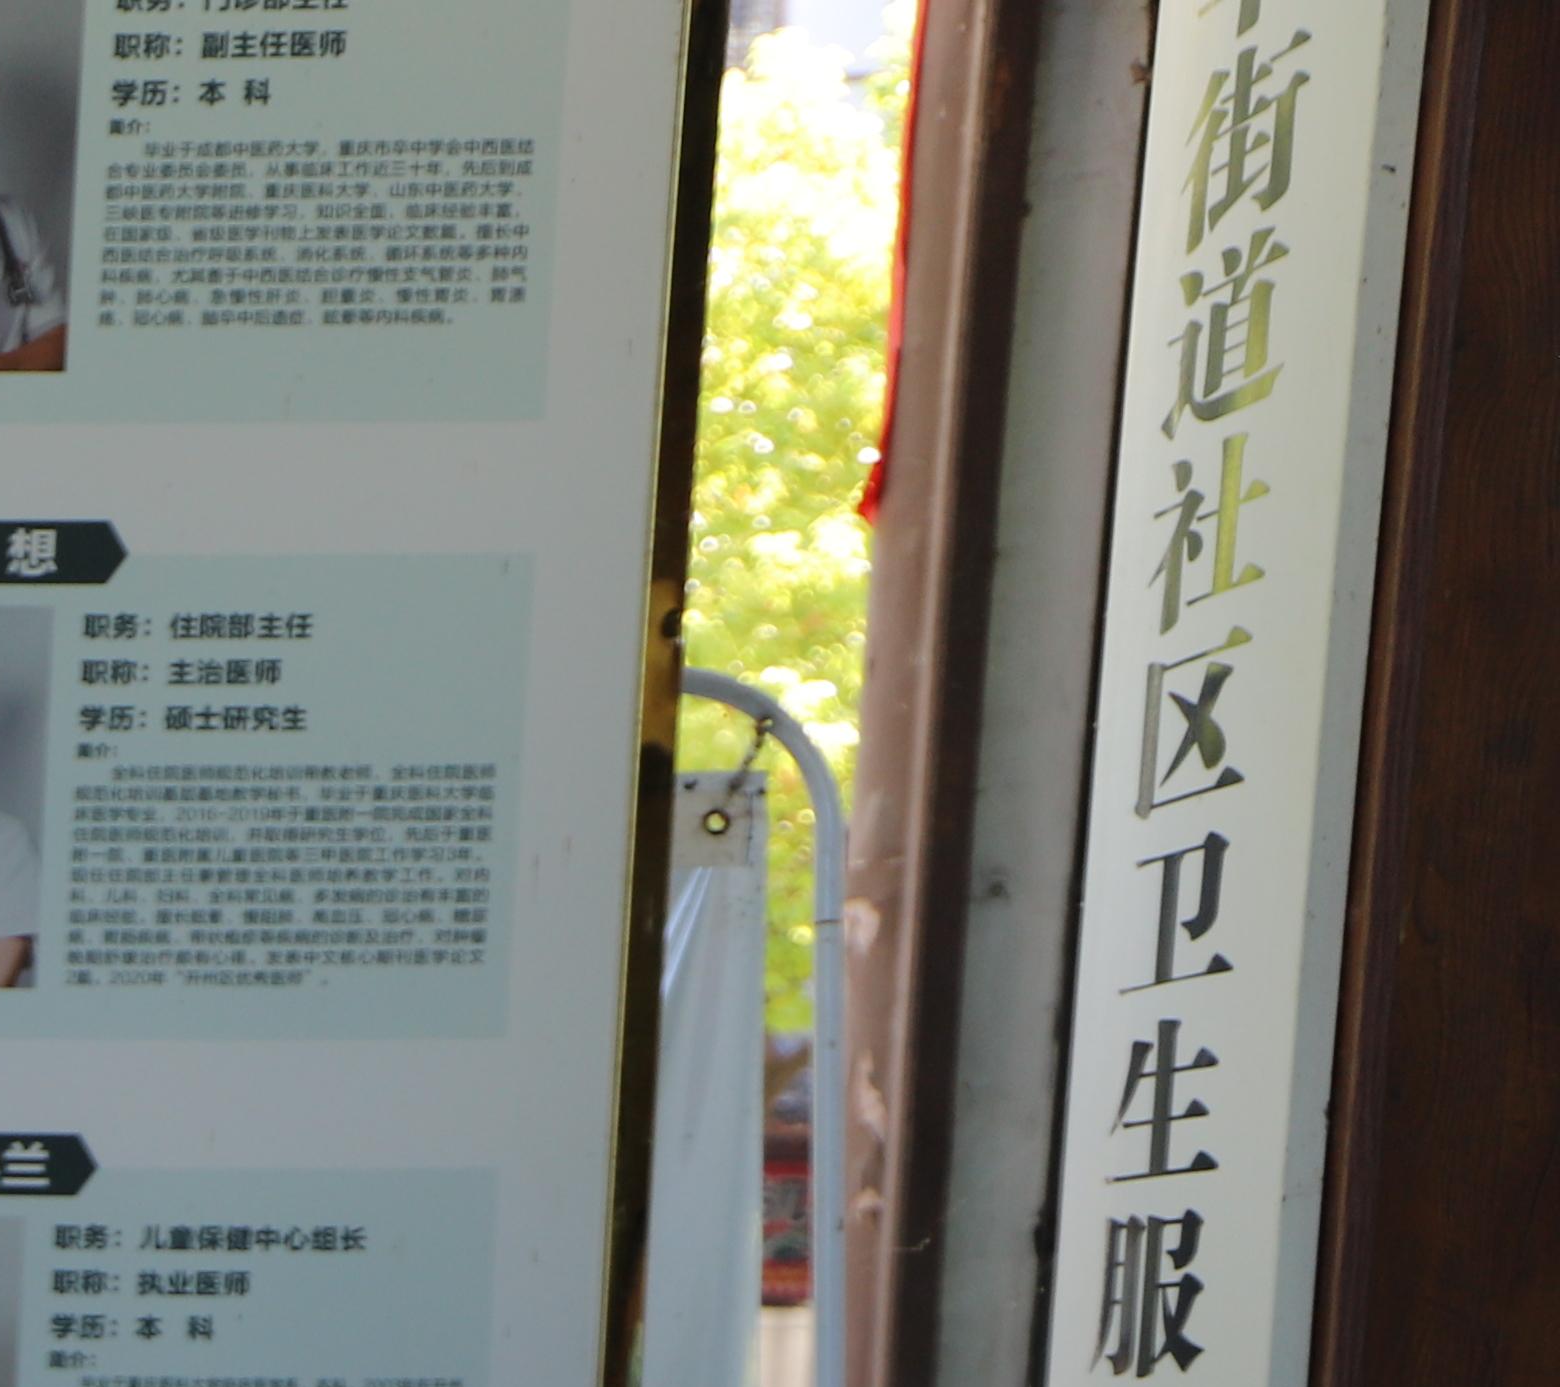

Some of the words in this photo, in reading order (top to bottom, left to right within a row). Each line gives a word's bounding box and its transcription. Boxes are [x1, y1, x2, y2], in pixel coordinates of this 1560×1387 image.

[114, 31, 346, 59] 职称：副主任医师
[83, 614, 312, 639] 职务：住院部主任
[81, 659, 281, 685] 职称：主治医师
[80, 706, 306, 731] 学历：硕士研究生
[54, 1225, 366, 1251] 职务：儿童保健中心组长
[52, 1270, 250, 1296] 职称：执业医师
